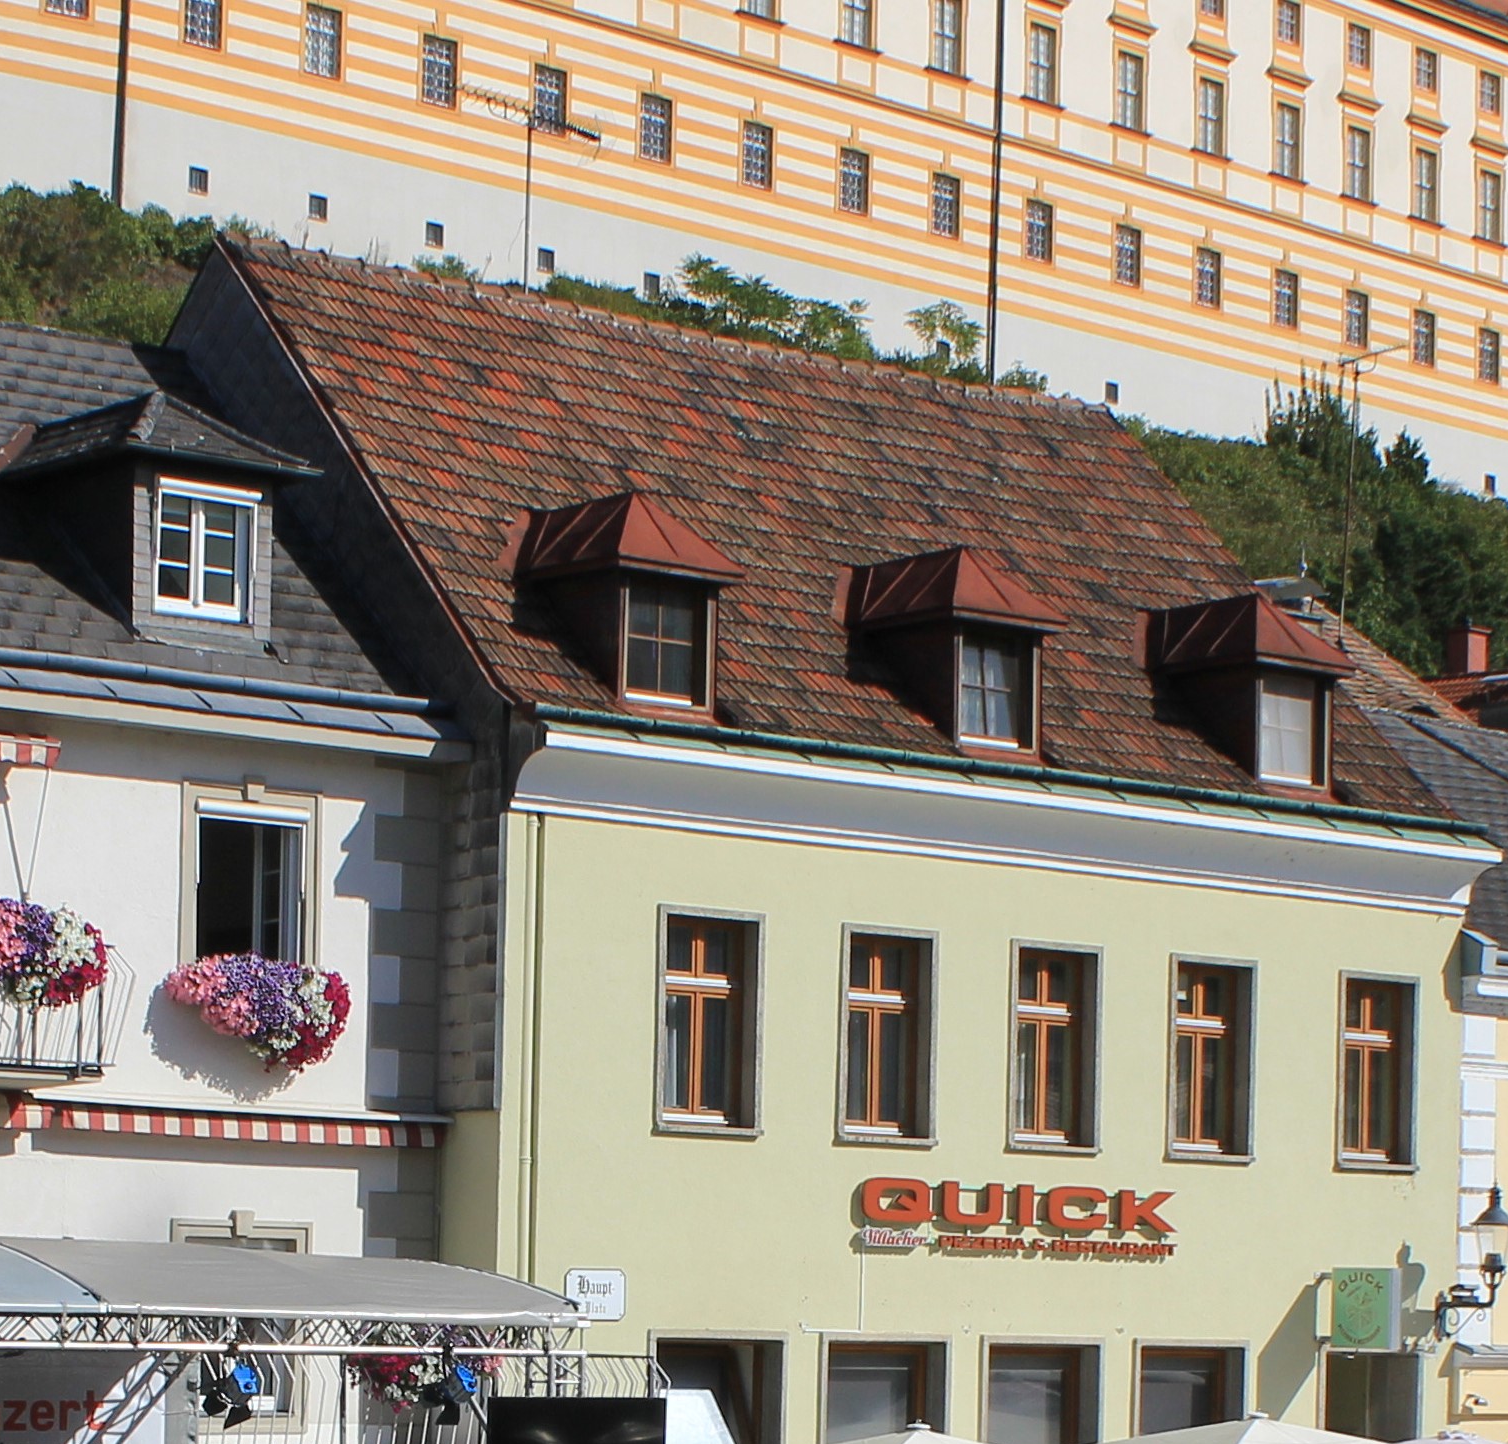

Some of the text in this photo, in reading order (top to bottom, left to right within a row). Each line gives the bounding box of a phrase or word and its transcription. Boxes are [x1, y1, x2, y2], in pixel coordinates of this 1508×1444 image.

[861, 1177, 1178, 1233] QUICK
[938, 1235, 1028, 1251] PIZZERIA
[1051, 1239, 1178, 1257] RESTAURANT
[1338, 1272, 1384, 1295] QUICK
